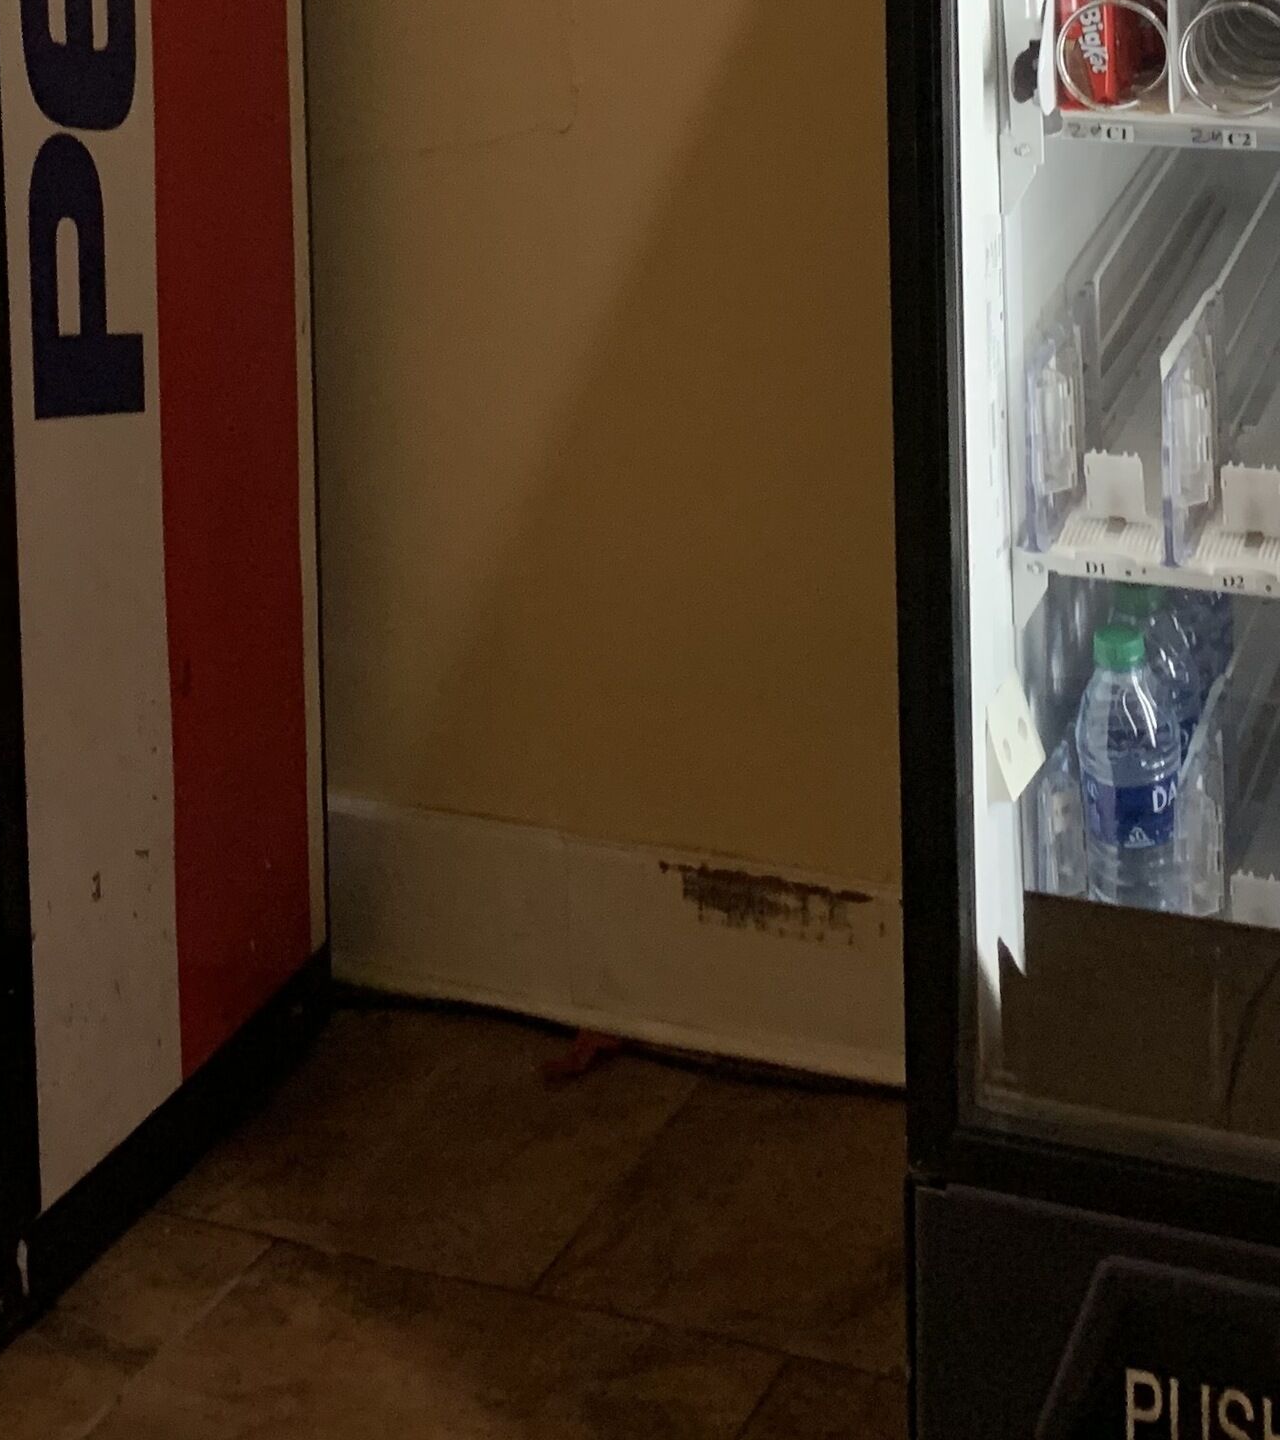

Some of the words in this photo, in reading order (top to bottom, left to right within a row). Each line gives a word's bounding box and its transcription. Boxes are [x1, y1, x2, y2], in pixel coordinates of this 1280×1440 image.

[1227, 131, 1252, 147] C2
[1084, 561, 1107, 576] D1
[1222, 575, 1245, 589] D2
